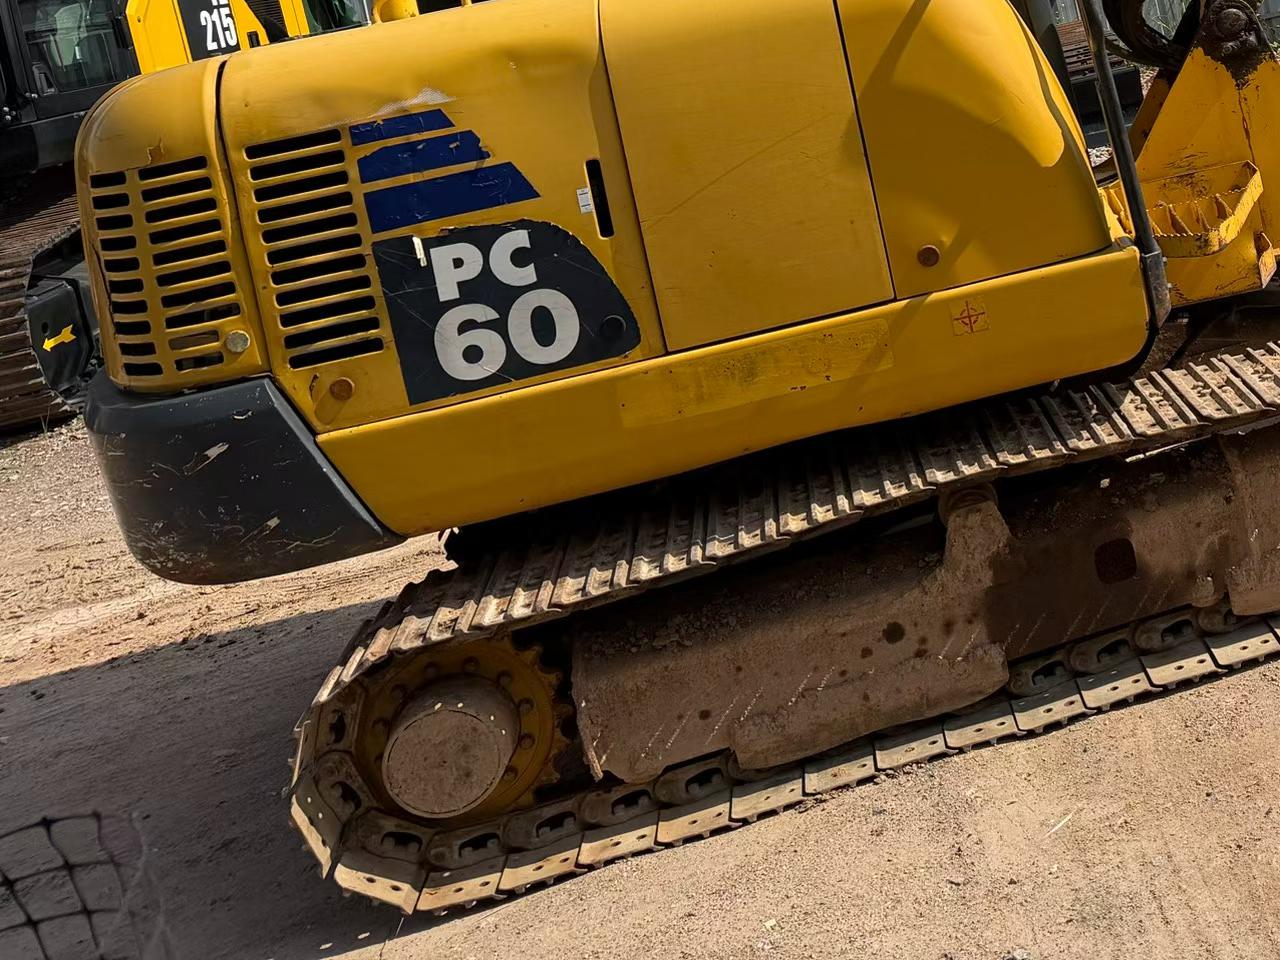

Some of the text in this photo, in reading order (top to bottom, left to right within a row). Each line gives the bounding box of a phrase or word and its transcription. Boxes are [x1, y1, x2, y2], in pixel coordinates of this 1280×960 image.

[199, 7, 238, 51] 215
[429, 229, 538, 302] PC
[434, 288, 580, 381] 60
